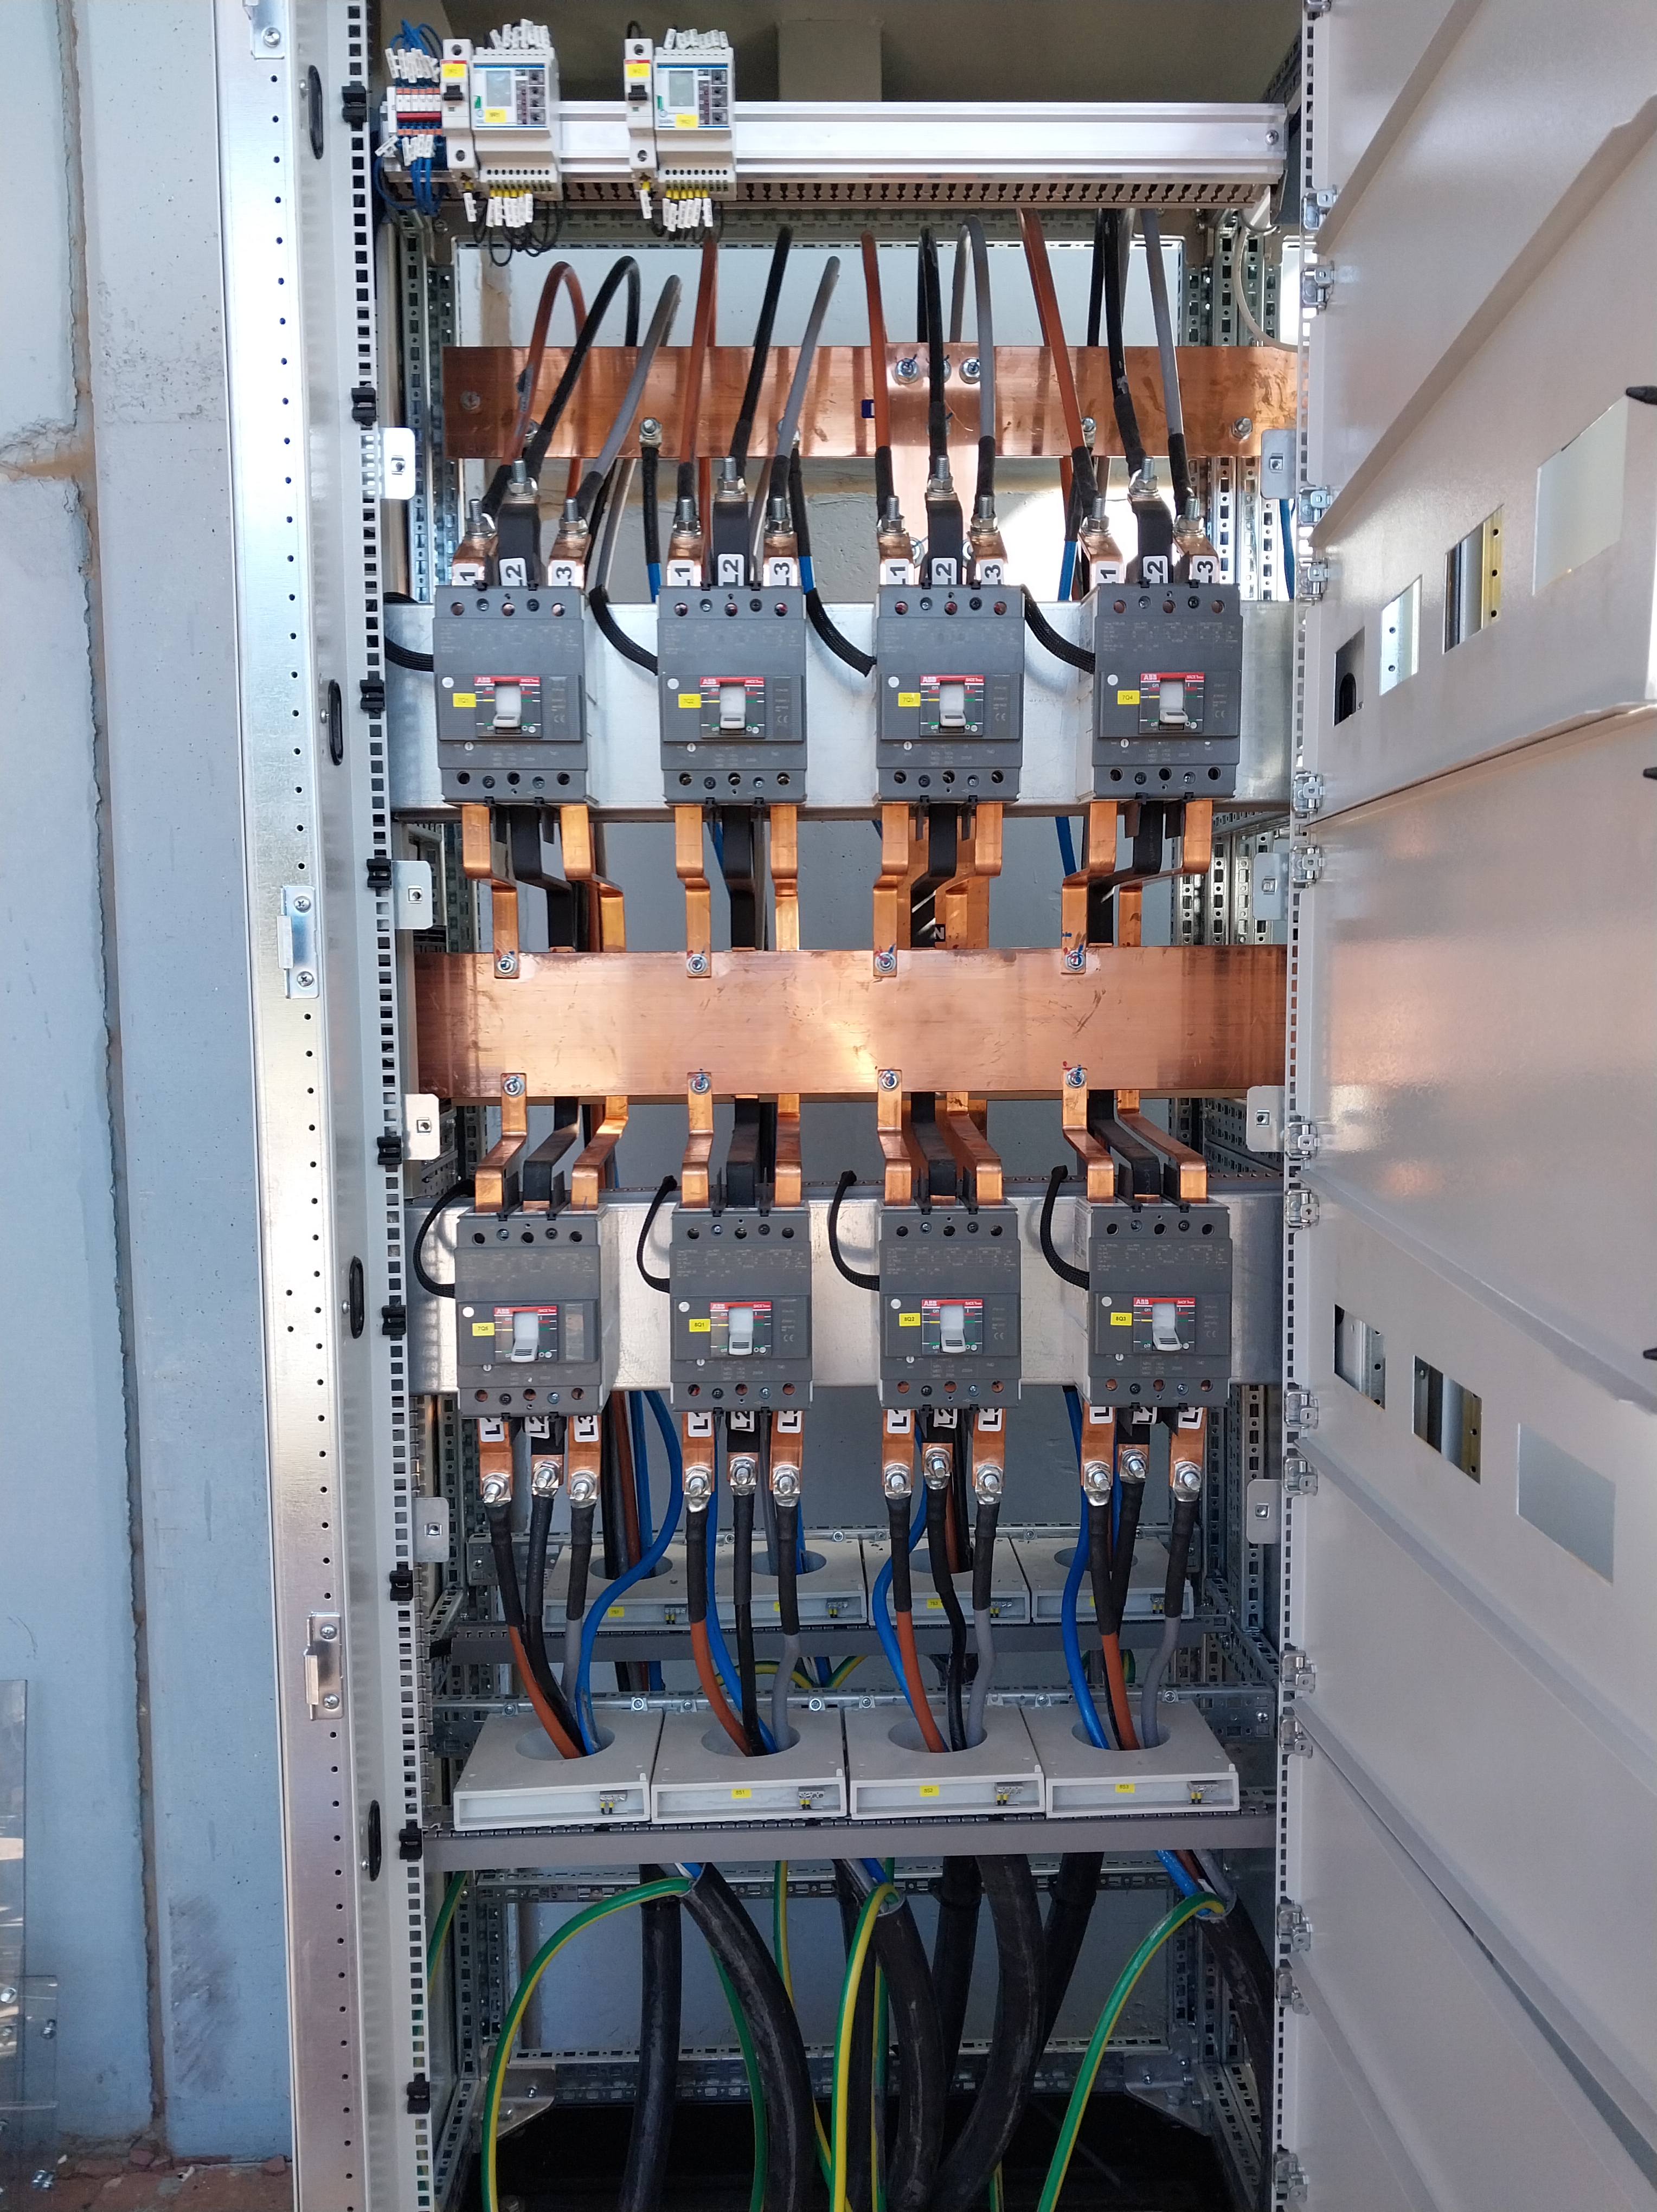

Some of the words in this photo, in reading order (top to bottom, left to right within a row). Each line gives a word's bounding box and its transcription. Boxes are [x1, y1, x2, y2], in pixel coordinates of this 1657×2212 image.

[934, 927, 945, 940] N
[735, 1411, 750, 1429] L2
[782, 1411, 798, 1426] L
[892, 1410, 907, 1426] L
[983, 1409, 998, 1425] L
[1182, 1408, 1199, 1423] L
